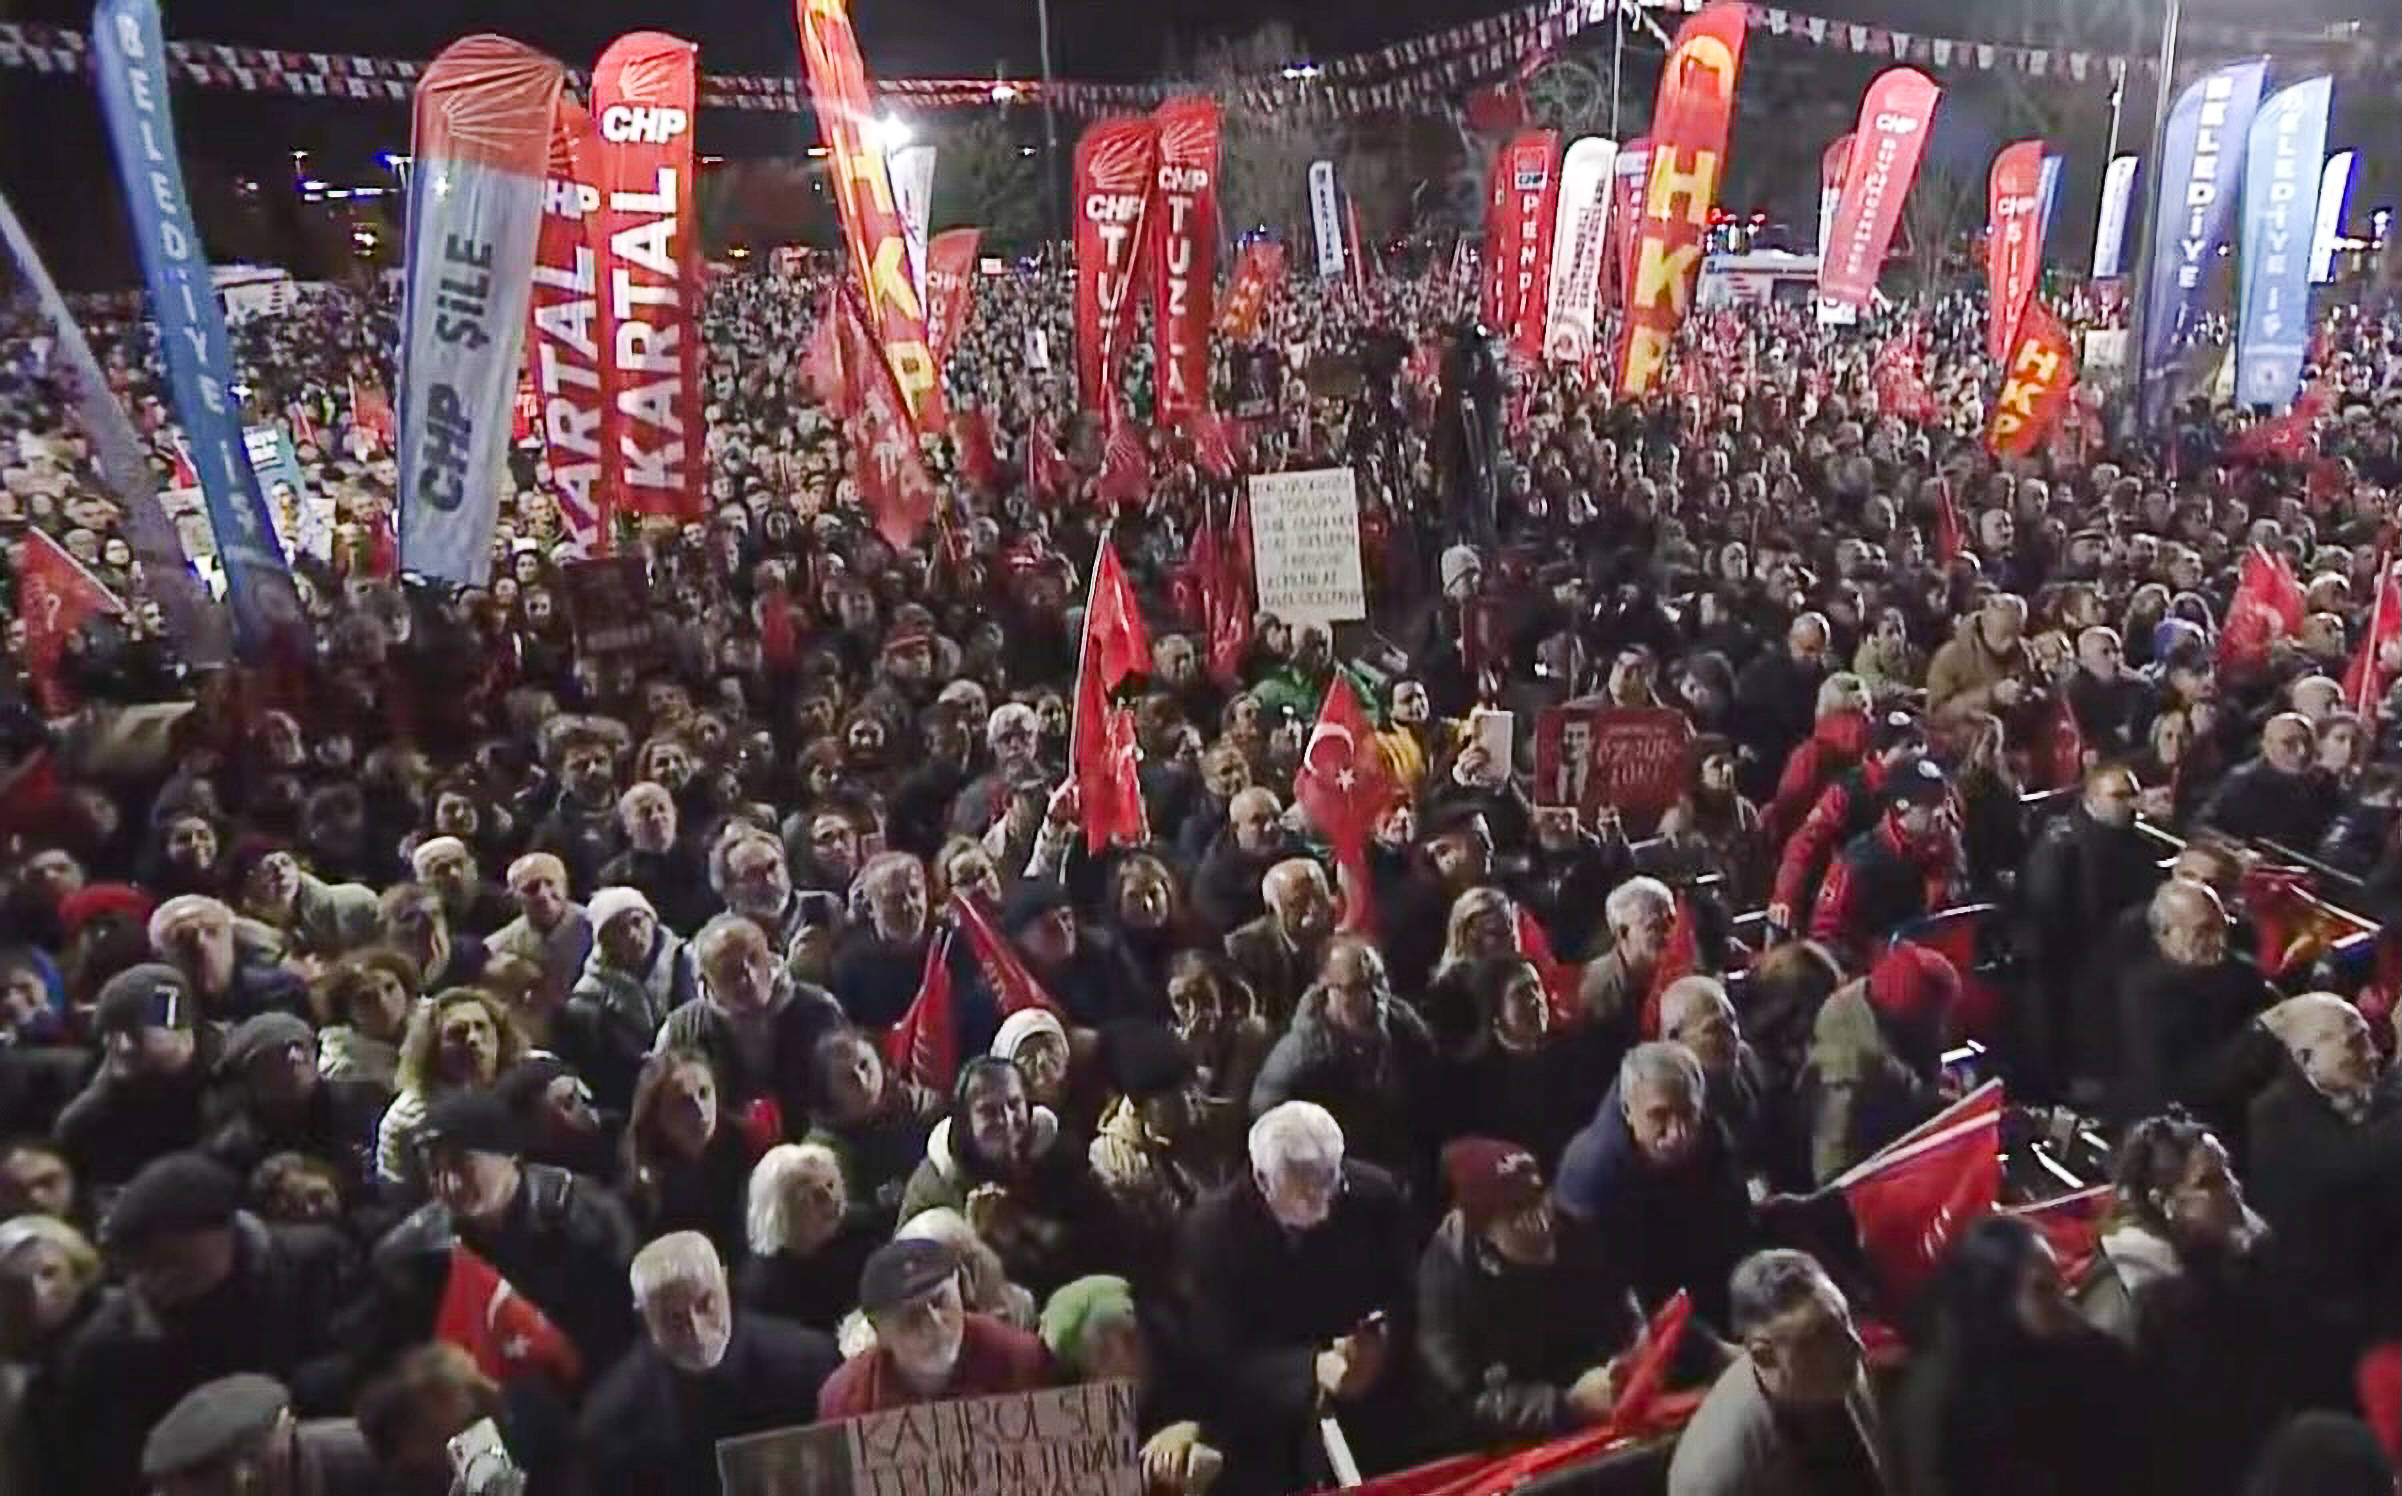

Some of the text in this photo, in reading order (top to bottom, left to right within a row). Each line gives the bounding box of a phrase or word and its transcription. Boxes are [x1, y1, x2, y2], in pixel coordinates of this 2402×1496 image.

[601, 104, 688, 145] CHP
[544, 178, 600, 220] HP
[1157, 165, 1209, 192] CHP
[1623, 144, 1717, 394] HKP
[608, 167, 687, 491] KARTAL
[418, 382, 472, 512] CHP
